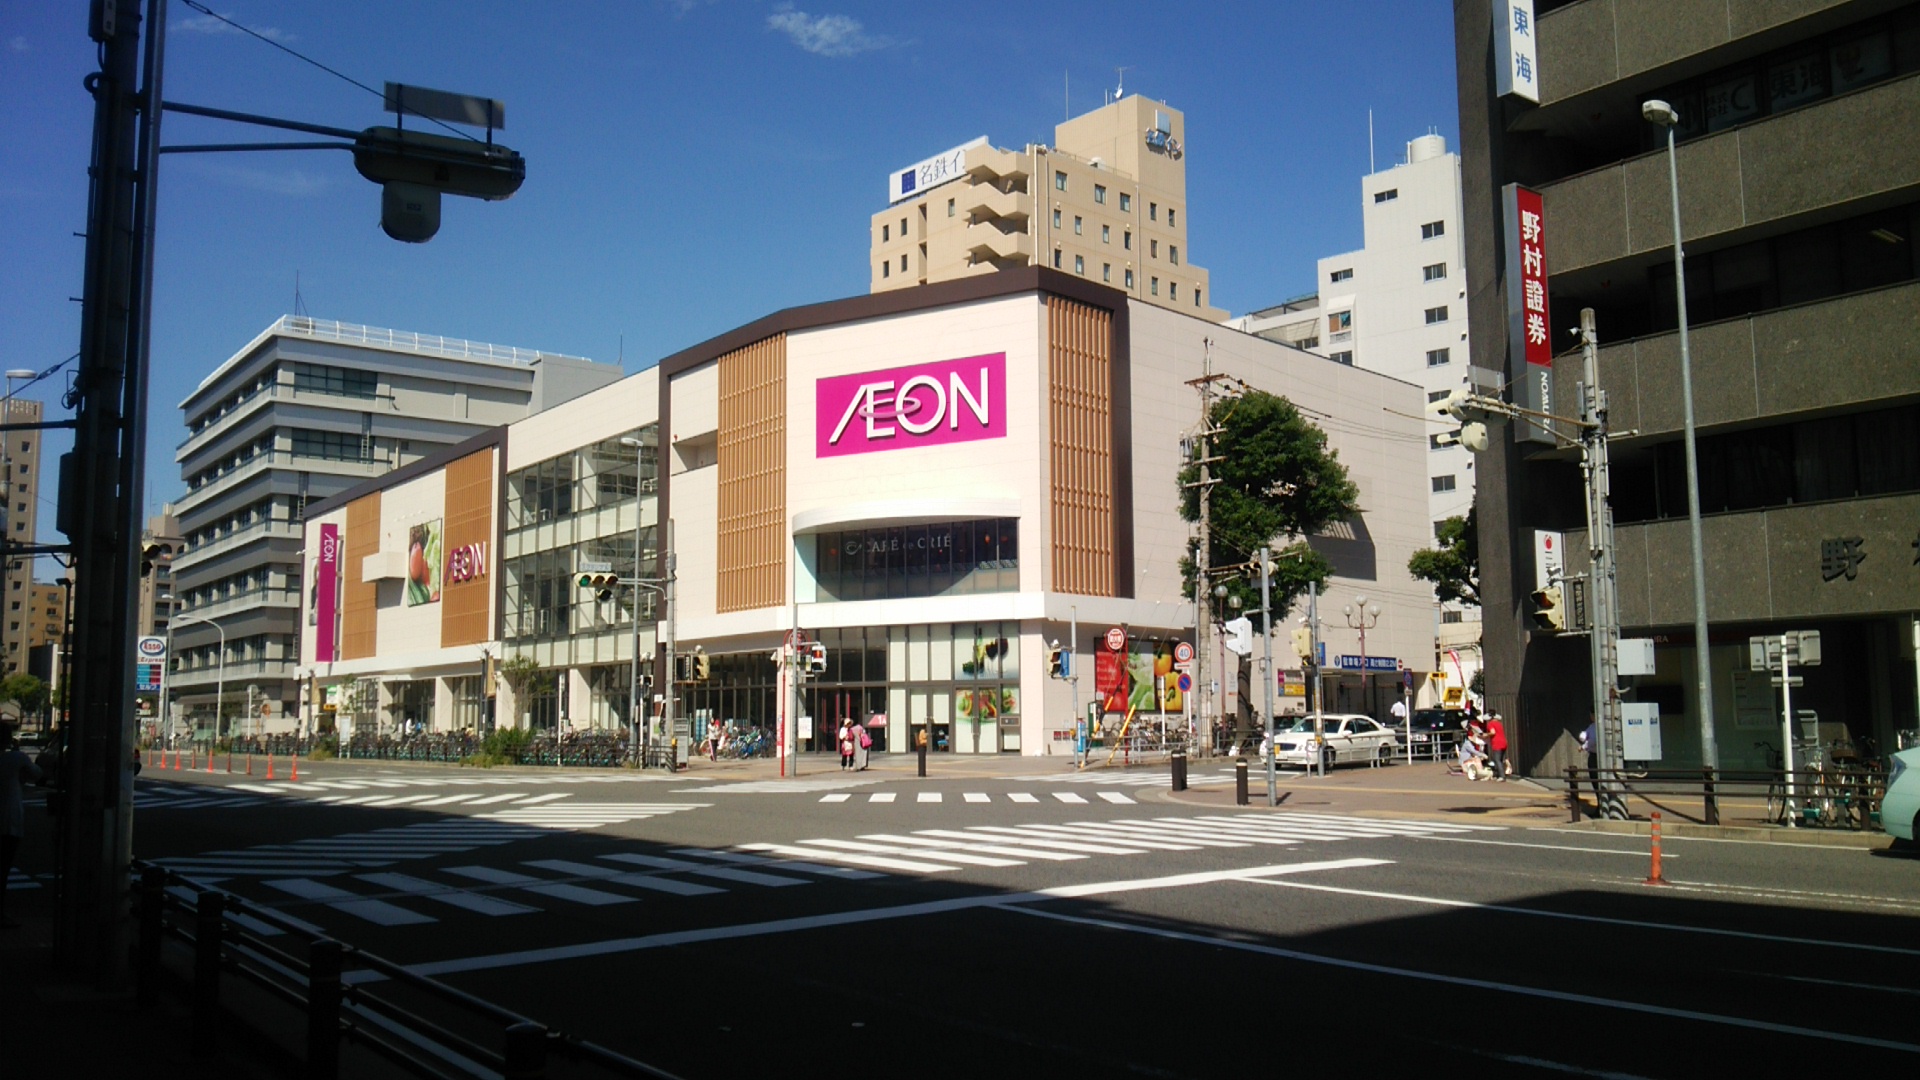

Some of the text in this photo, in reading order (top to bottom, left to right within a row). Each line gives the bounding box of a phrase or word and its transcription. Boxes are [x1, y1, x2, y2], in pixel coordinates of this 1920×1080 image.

[1513, 5, 1532, 83] 東海
[918, 151, 966, 187] 名鉄イ
[1521, 210, 1547, 345] 野村證券
[1179, 648, 1190, 658] 40
